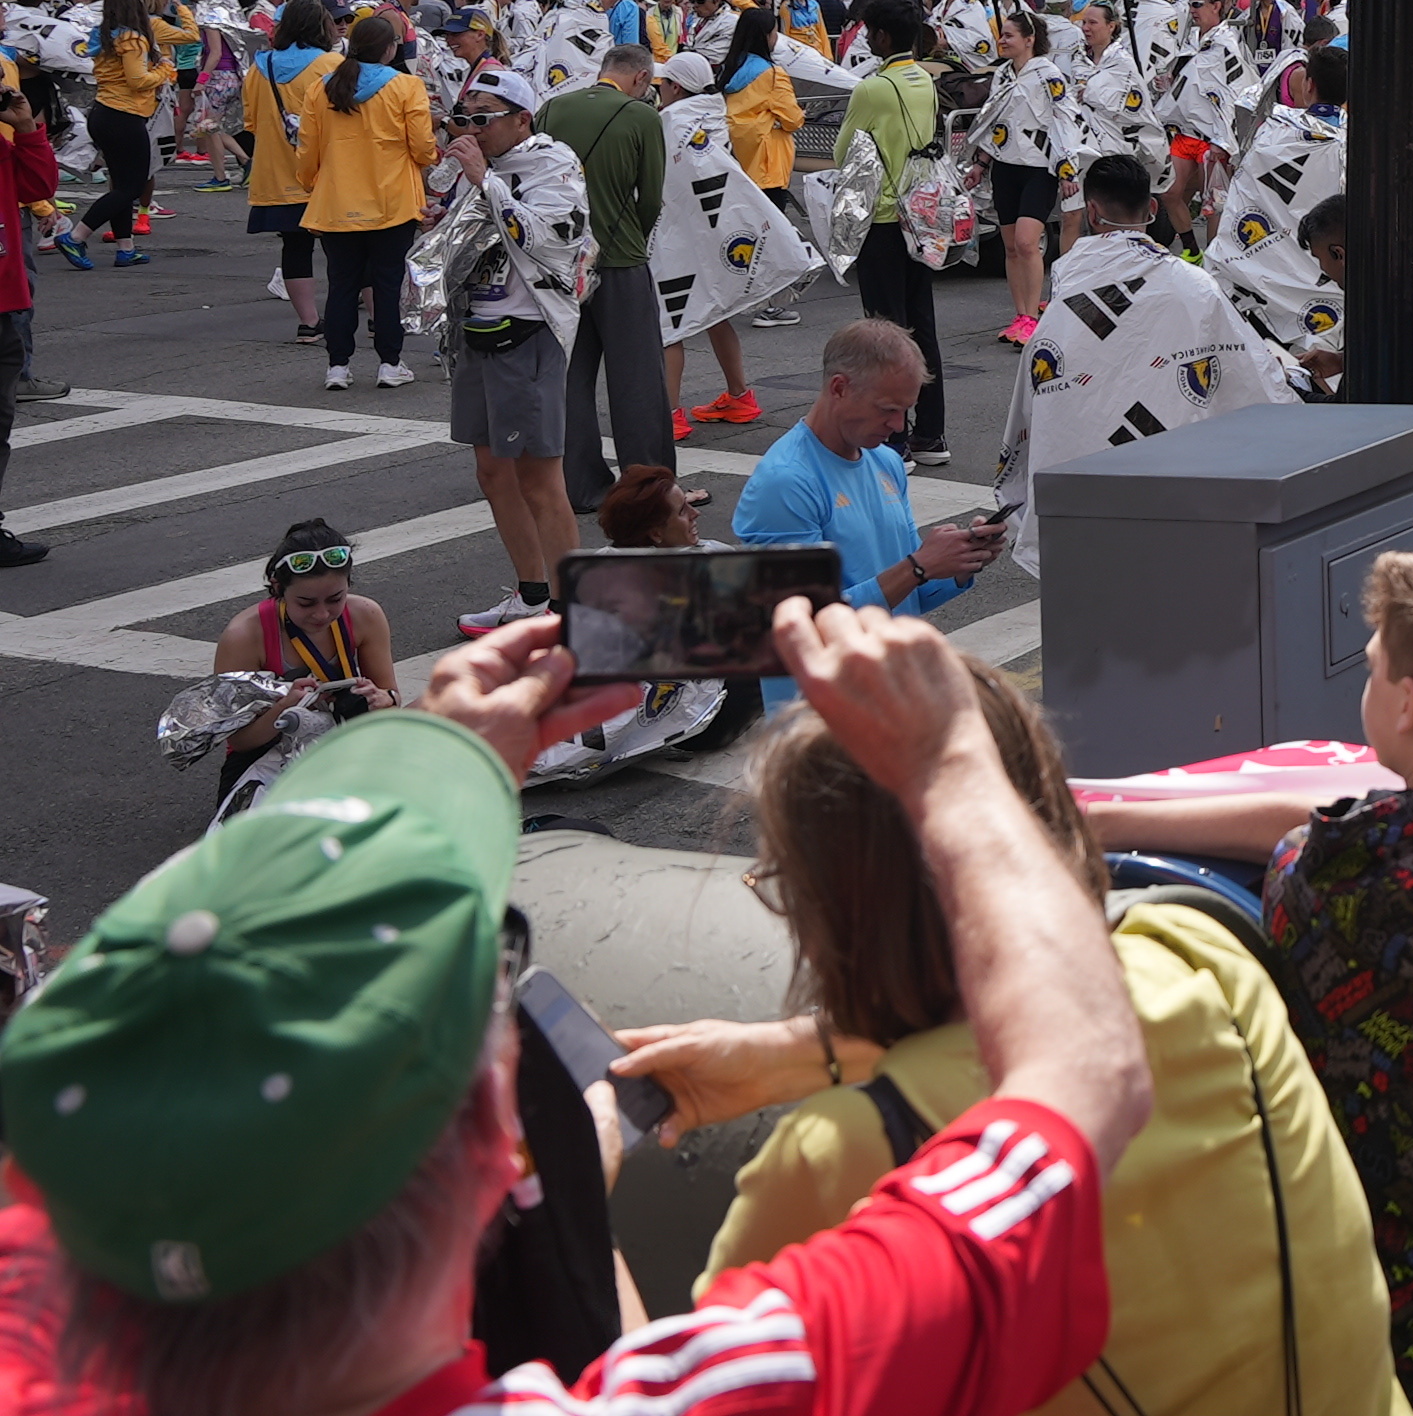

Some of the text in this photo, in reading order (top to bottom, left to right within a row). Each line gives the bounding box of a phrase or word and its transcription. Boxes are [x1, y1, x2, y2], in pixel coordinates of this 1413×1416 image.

[753, 235, 769, 267] AMERICA
[1252, 235, 1285, 257] AMERICA
[1218, 343, 1246, 352] BANK
[1036, 382, 1071, 397] AMERICA
